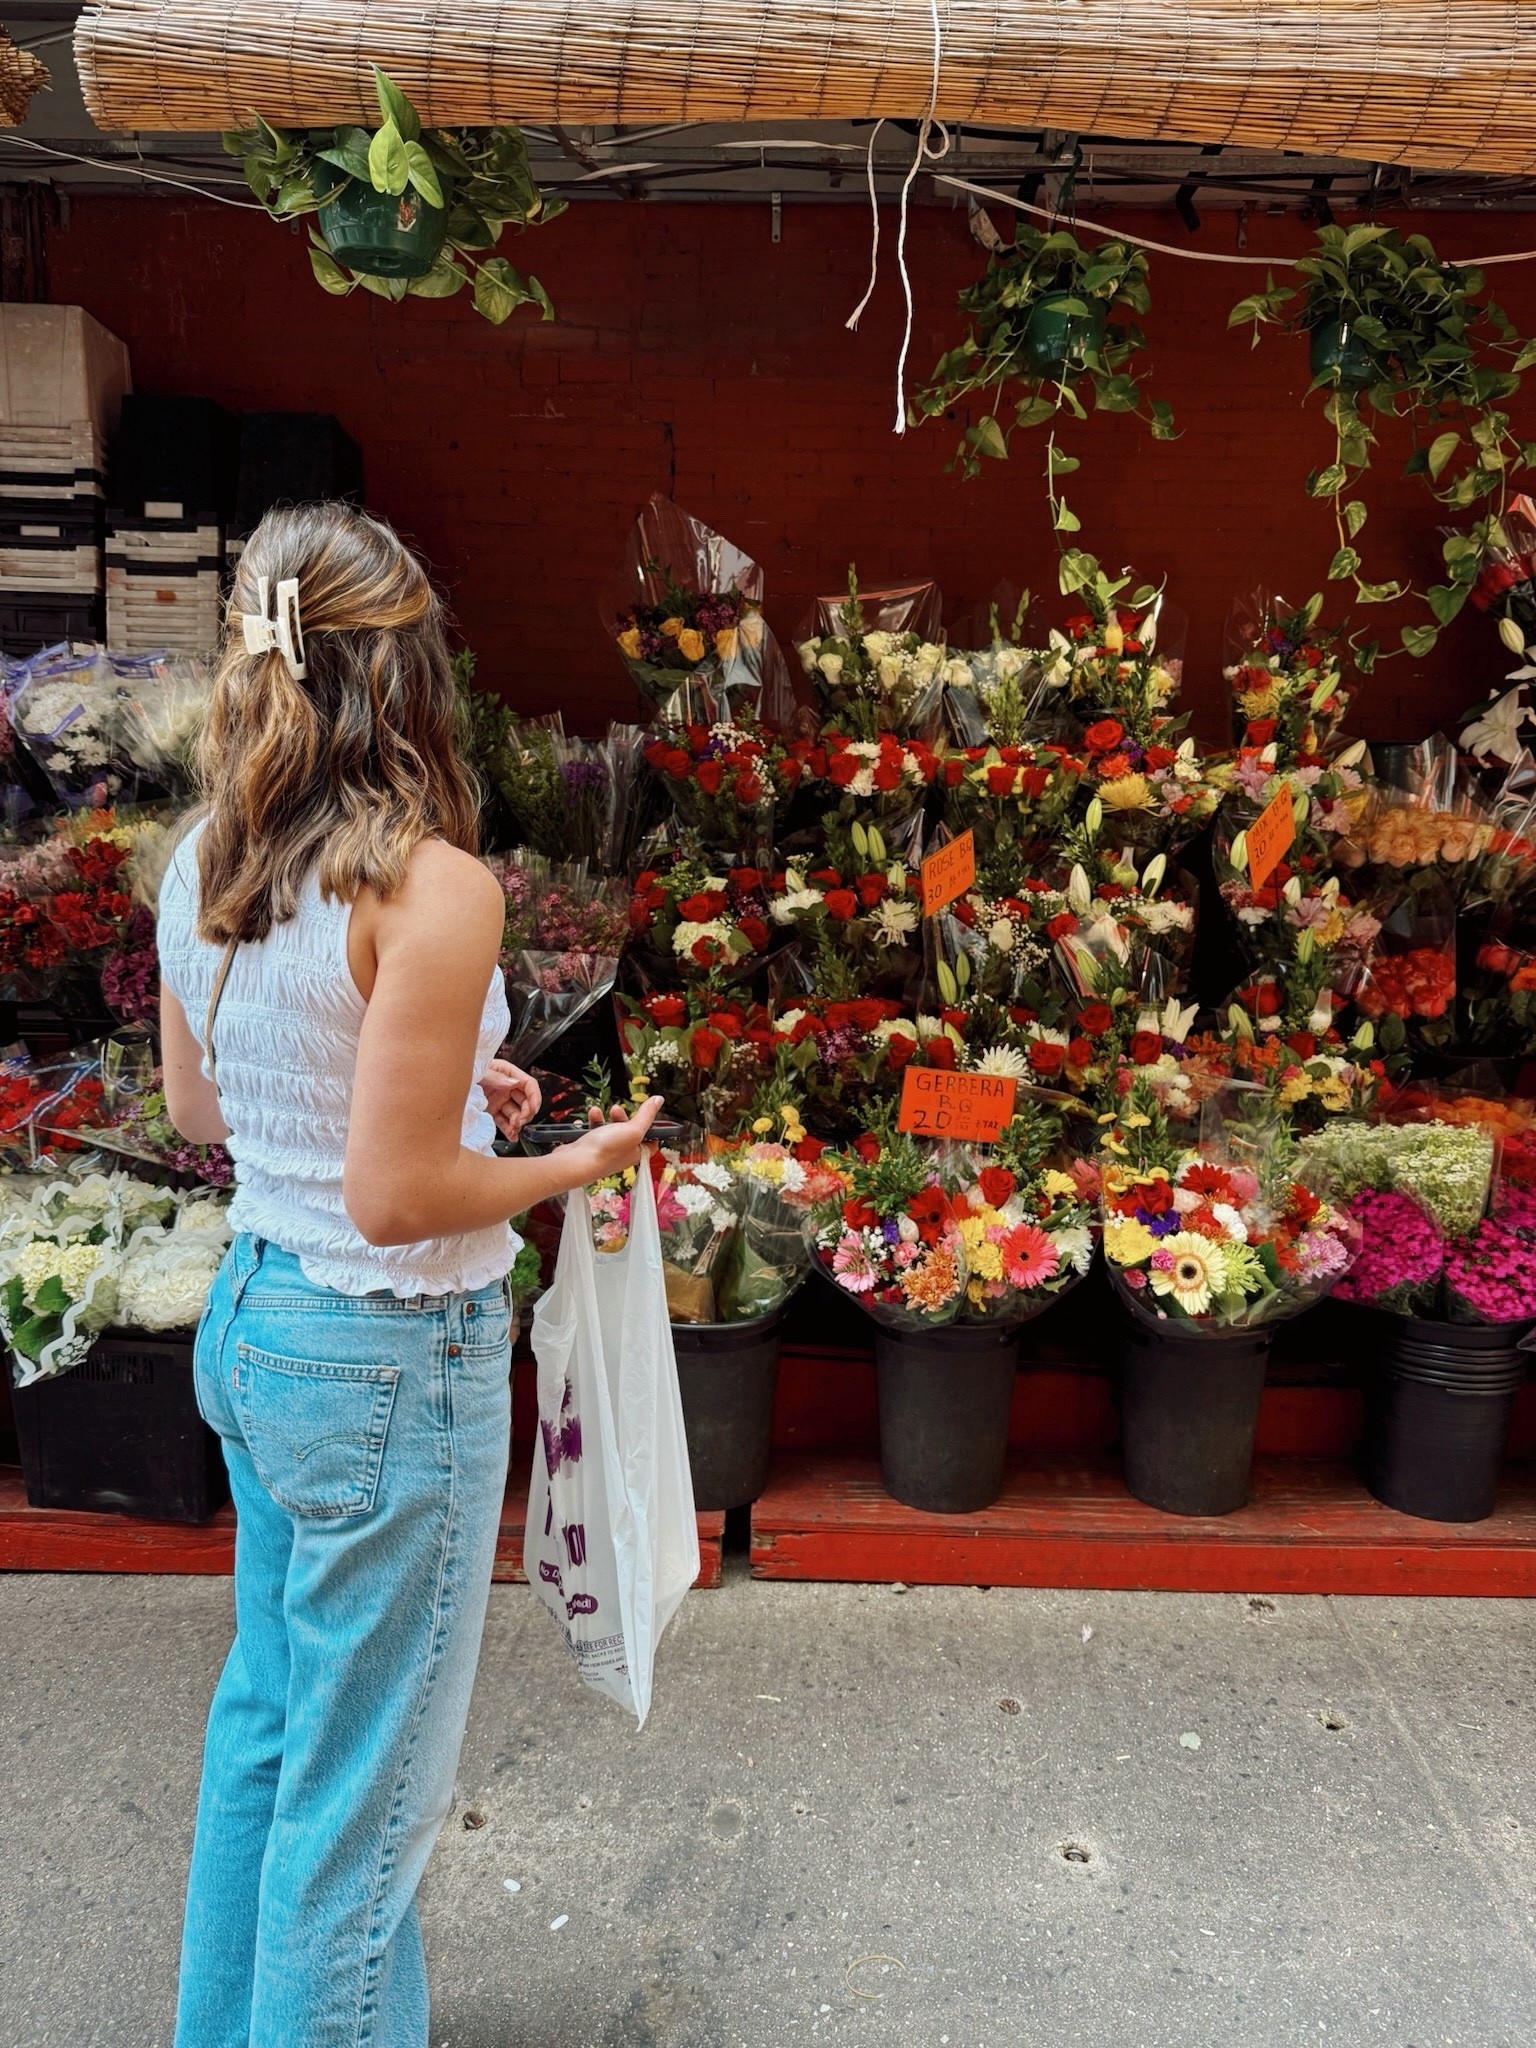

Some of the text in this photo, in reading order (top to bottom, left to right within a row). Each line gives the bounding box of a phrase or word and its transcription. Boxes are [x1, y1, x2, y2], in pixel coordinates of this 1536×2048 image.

[929, 850, 955, 880] ROSE
[928, 884, 942, 905] 30
[916, 1072, 1004, 1098] GERBERA
[594, 1639, 608, 1650] FOR
